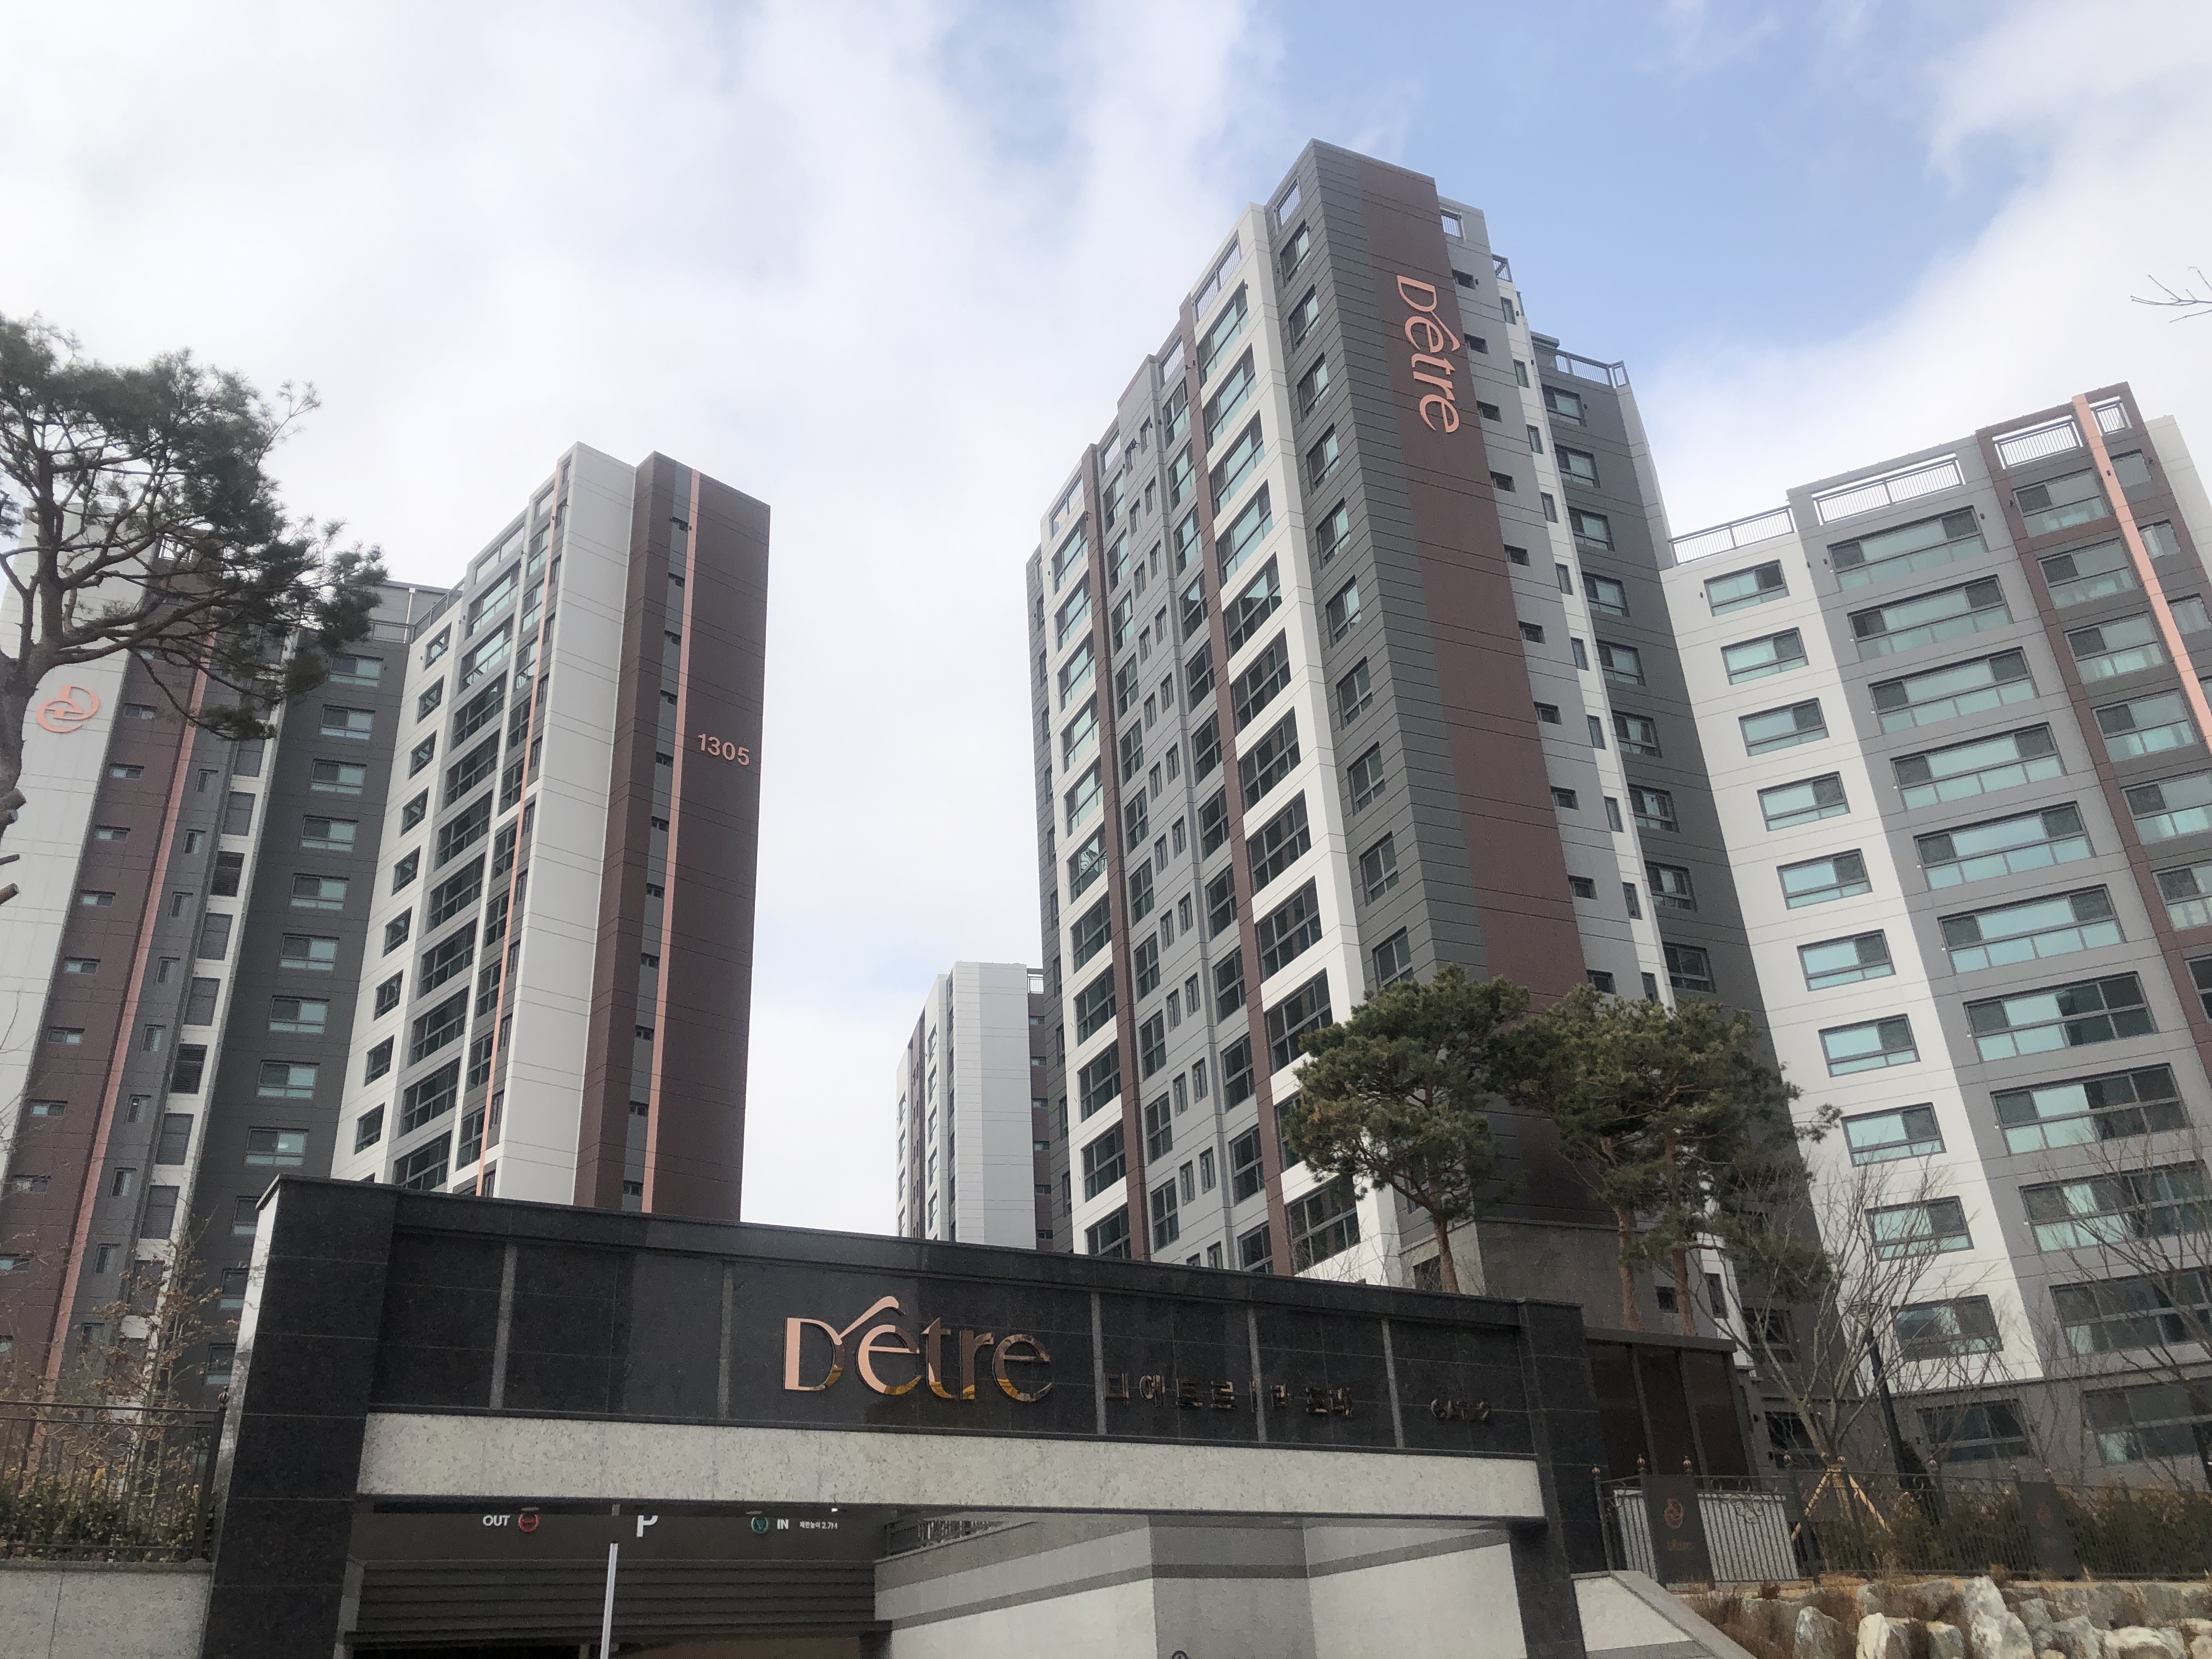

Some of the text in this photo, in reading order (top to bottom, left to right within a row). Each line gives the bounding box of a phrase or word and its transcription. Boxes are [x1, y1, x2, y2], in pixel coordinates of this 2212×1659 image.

[698, 733, 749, 766] 1305
[483, 1514, 510, 1527] OUT
[777, 1519, 789, 1530] IN
